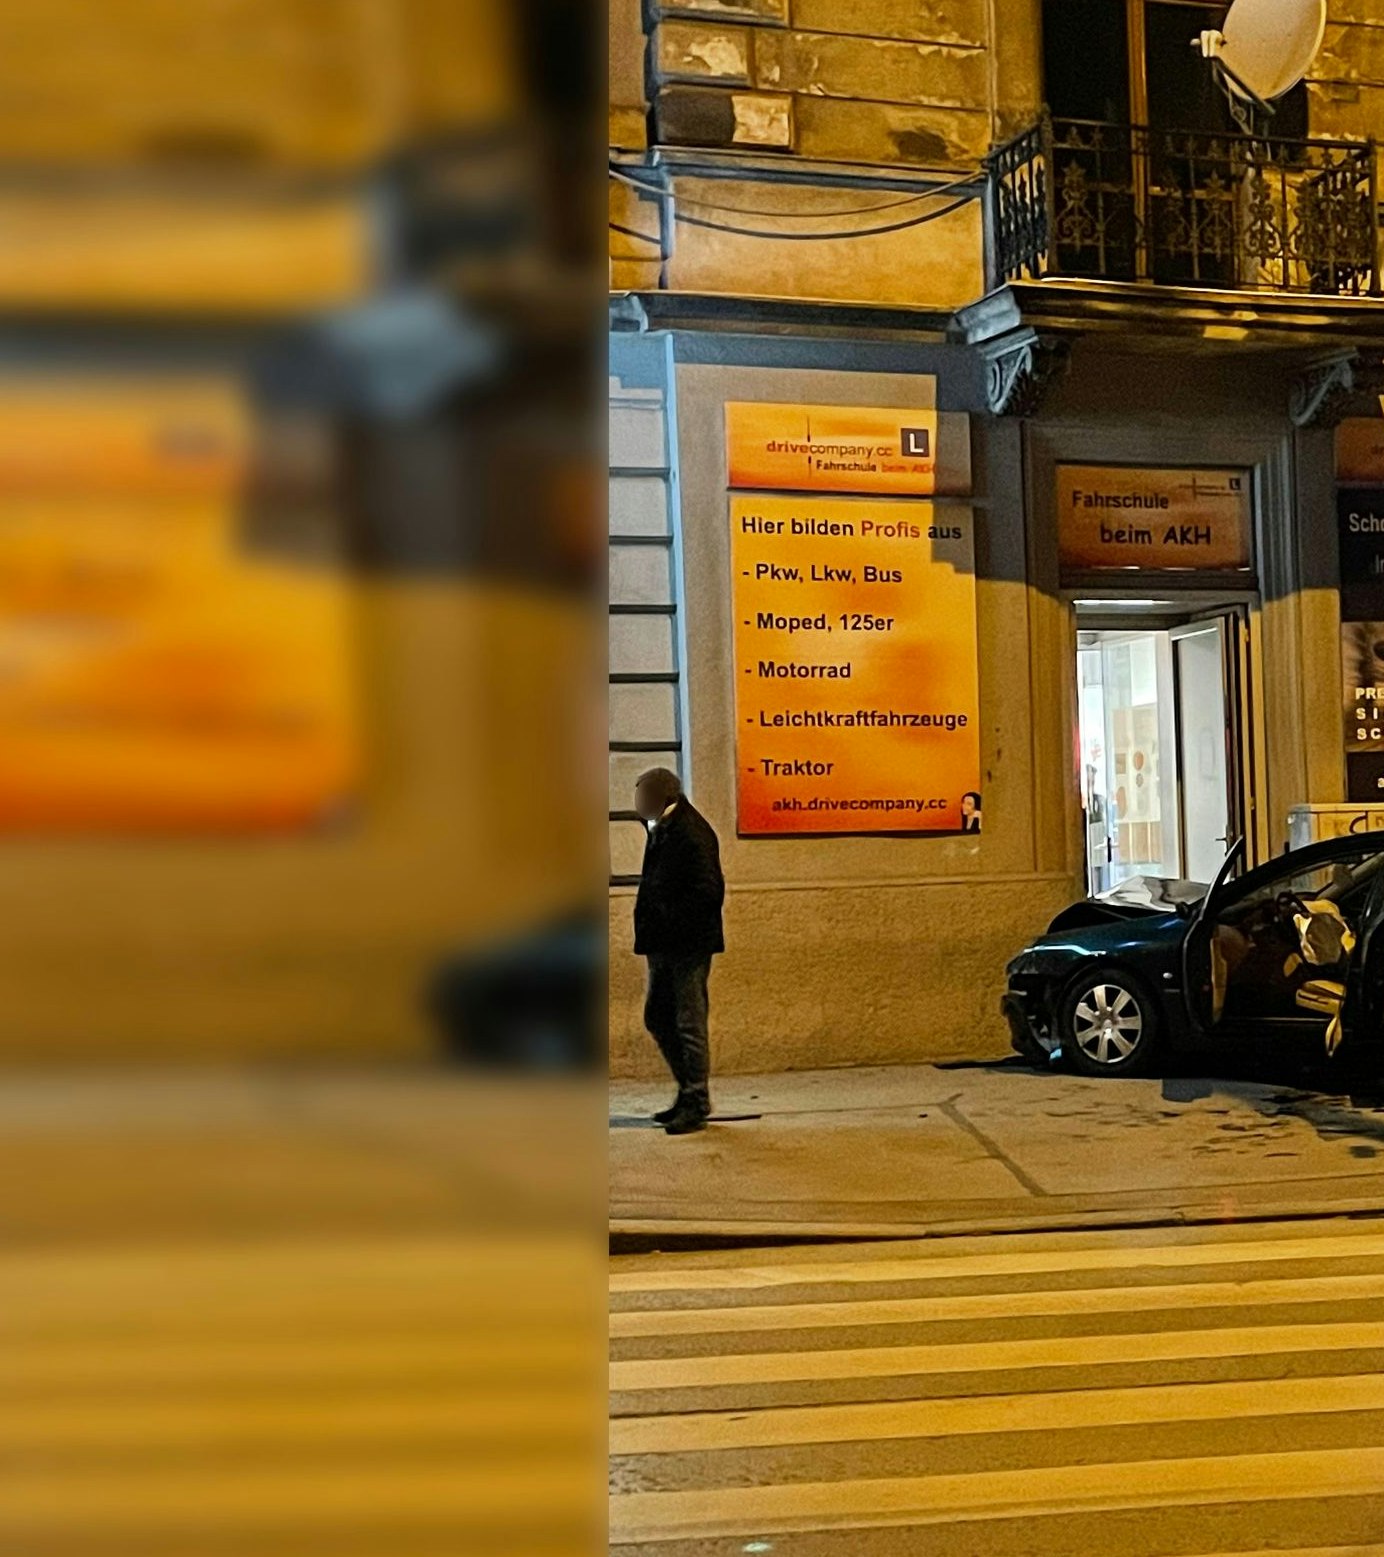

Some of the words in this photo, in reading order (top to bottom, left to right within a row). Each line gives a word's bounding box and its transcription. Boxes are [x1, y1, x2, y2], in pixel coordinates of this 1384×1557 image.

[766, 441, 893, 458] drivecompany.cc
[909, 433, 924, 453] L
[816, 460, 877, 473] Fahrschule
[1072, 490, 1169, 509] Fahrschule
[742, 516, 784, 535] Hier
[791, 518, 854, 536] bilden
[861, 520, 920, 538] Profis
[928, 525, 962, 539] aus
[1100, 523, 1152, 545] beim
[1163, 525, 1211, 545] AKH
[756, 563, 804, 584] Pkw,
[811, 564, 856, 585] Lkw,
[863, 565, 902, 583] Bus
[757, 612, 832, 634] Moped,
[839, 613, 894, 631] 125er
[758, 661, 851, 679] Motorrad
[760, 710, 968, 731] Leichtkraftfahrzeuge
[760, 758, 834, 776] Traktor
[772, 796, 947, 813] akh.drivecompany.cc
